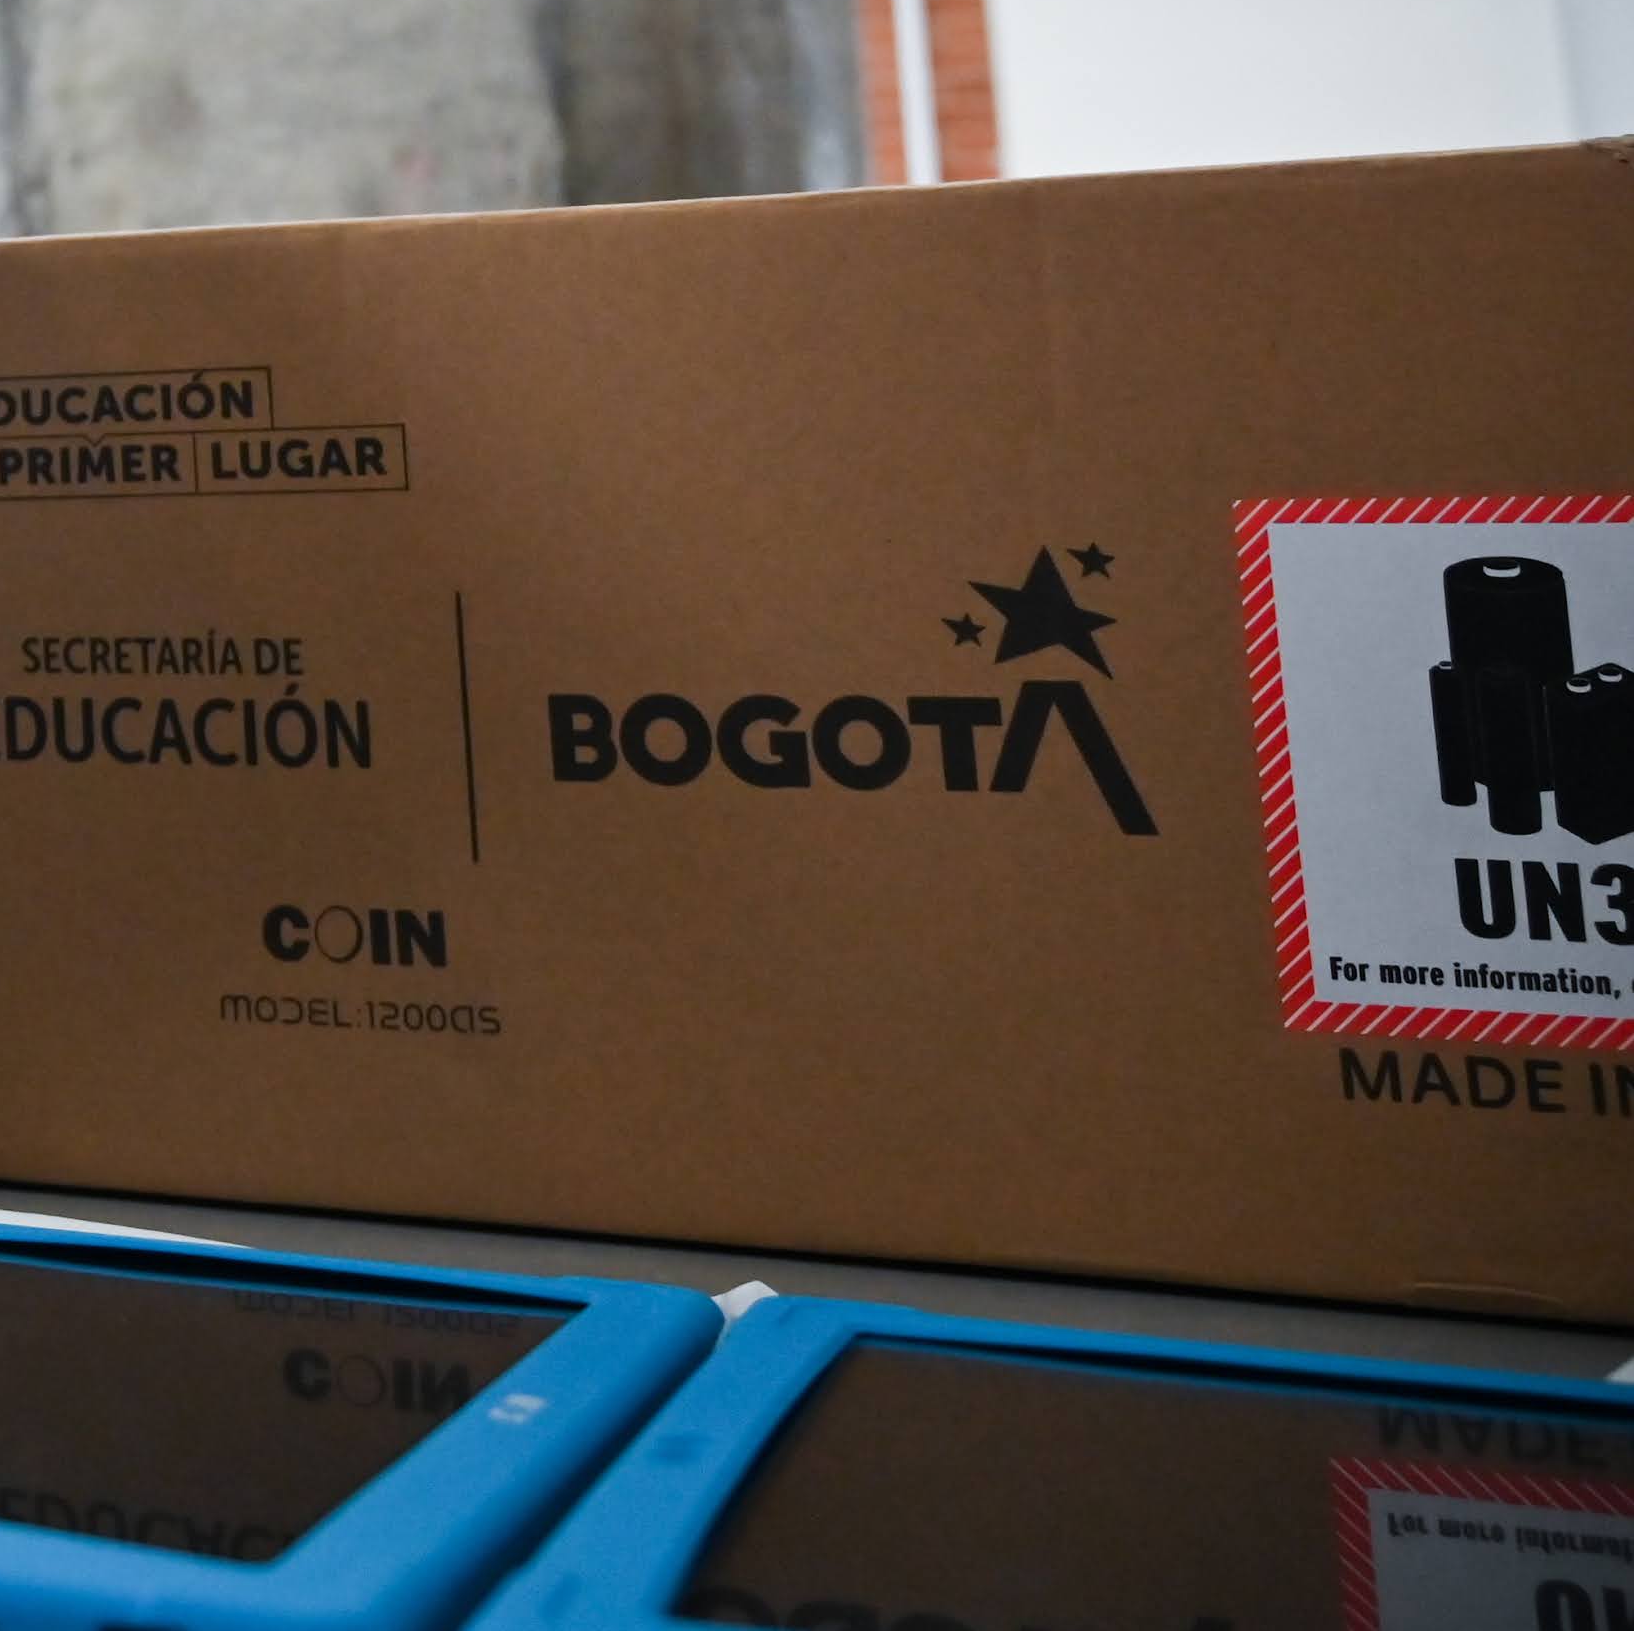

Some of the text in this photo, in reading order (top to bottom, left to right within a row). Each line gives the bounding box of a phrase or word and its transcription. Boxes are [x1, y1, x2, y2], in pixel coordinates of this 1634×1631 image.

[209, 436, 388, 481] LUGAR
[21, 628, 306, 676] SECRETARÍA DE
[262, 904, 448, 968] COIN
[1329, 956, 1371, 982] For
[1379, 962, 1445, 987] more
[1453, 961, 1622, 1001] information,
[1337, 1046, 1568, 1114] MADE
